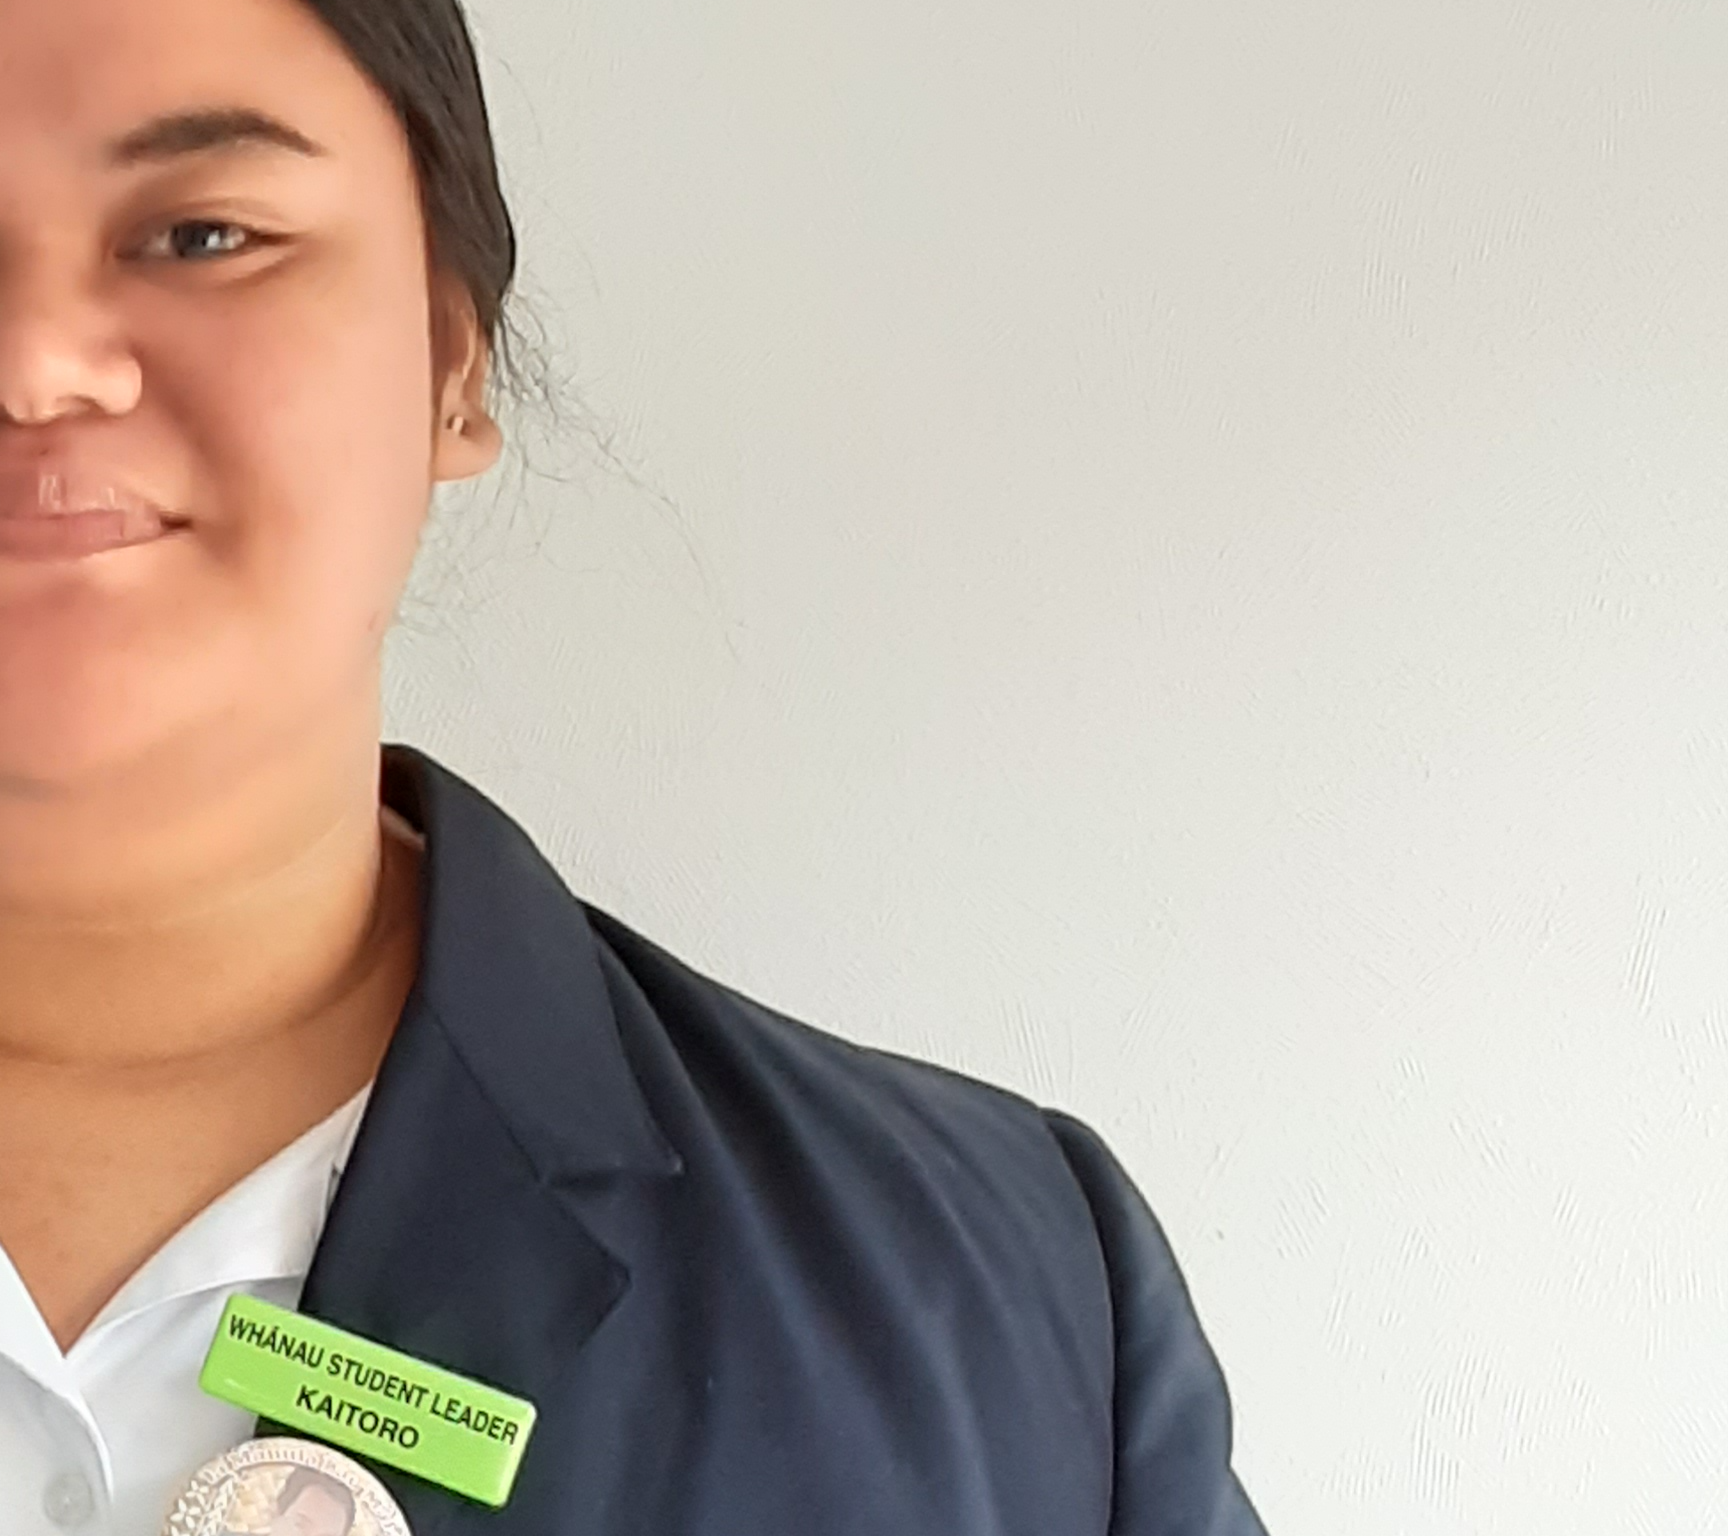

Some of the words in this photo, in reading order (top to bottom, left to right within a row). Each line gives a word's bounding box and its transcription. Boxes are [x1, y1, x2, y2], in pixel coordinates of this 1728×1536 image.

[295, 1385, 420, 1449] KAITORO
[327, 1353, 429, 1409] STUDENT
[430, 1393, 520, 1446] LEADER
